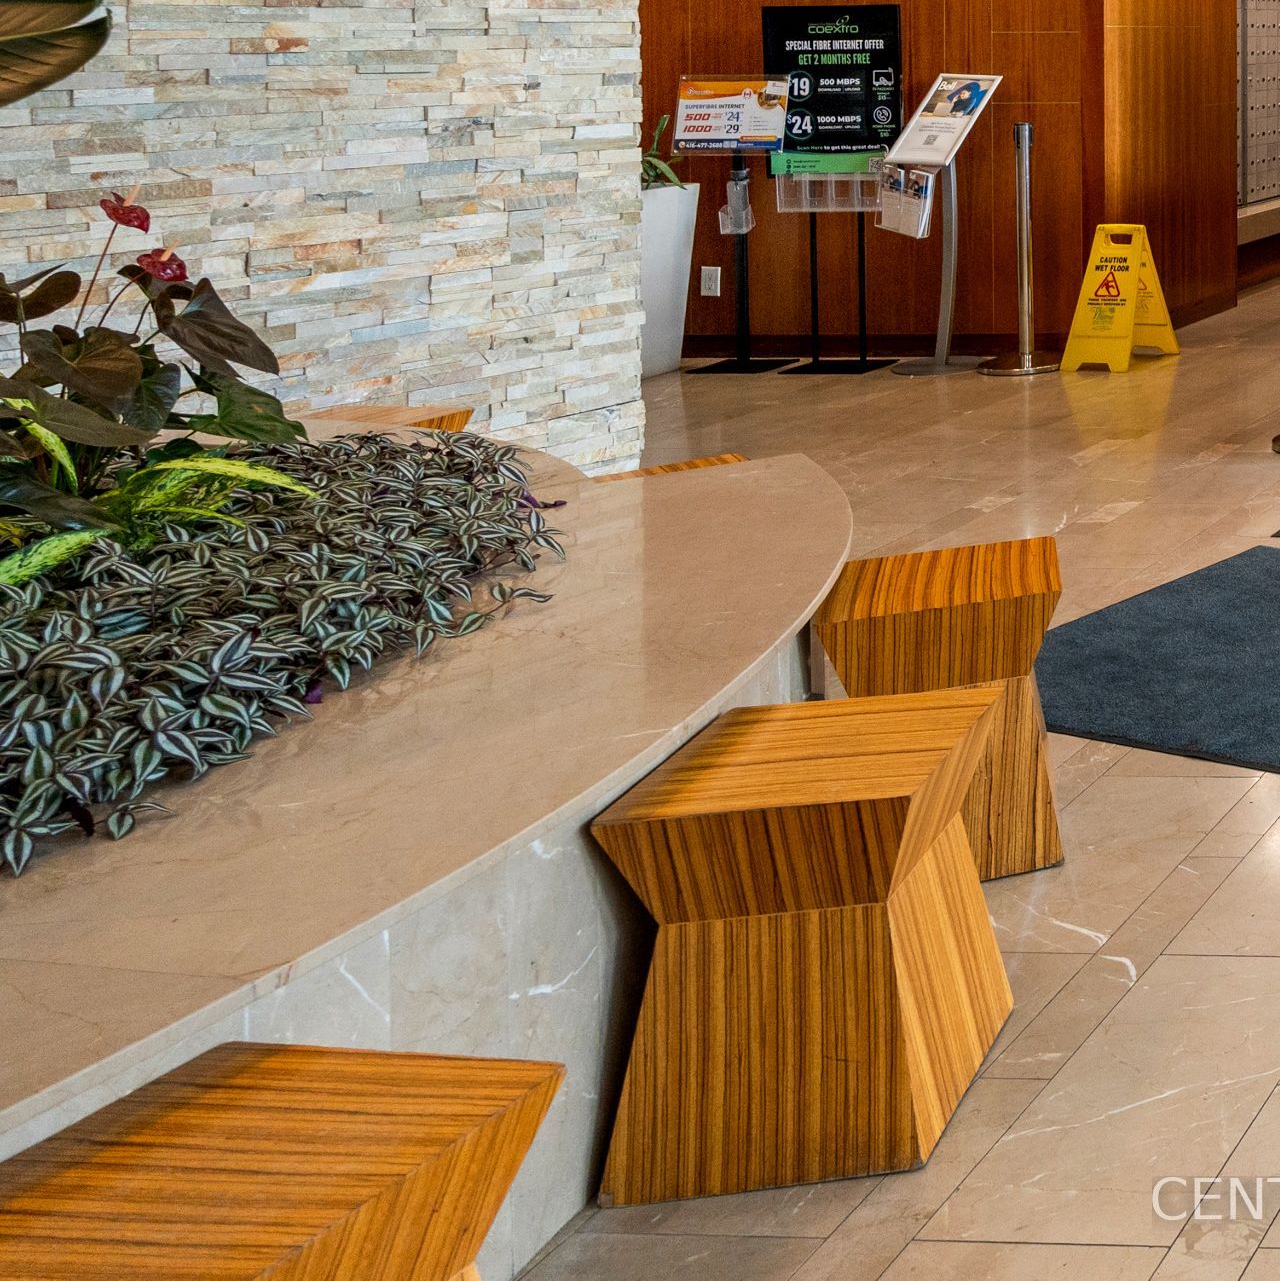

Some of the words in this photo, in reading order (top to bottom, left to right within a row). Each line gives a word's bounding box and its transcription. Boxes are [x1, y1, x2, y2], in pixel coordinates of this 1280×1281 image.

[808, 24, 859, 34] coextro
[785, 40, 812, 51] SPECIAL
[813, 40, 831, 50] FIBRE
[832, 39, 863, 50] INTERNET
[864, 39, 884, 49] OFFER
[798, 54, 812, 65] GET
[814, 54, 819, 65] 2
[820, 53, 852, 65] MONTHS
[853, 53, 871, 64] FREE
[938, 81, 958, 91] Bell
[684, 113, 711, 121] 500
[683, 125, 713, 133] 1000
[787, 114, 813, 134] $24
[1099, 256, 1128, 264] CAUTION
